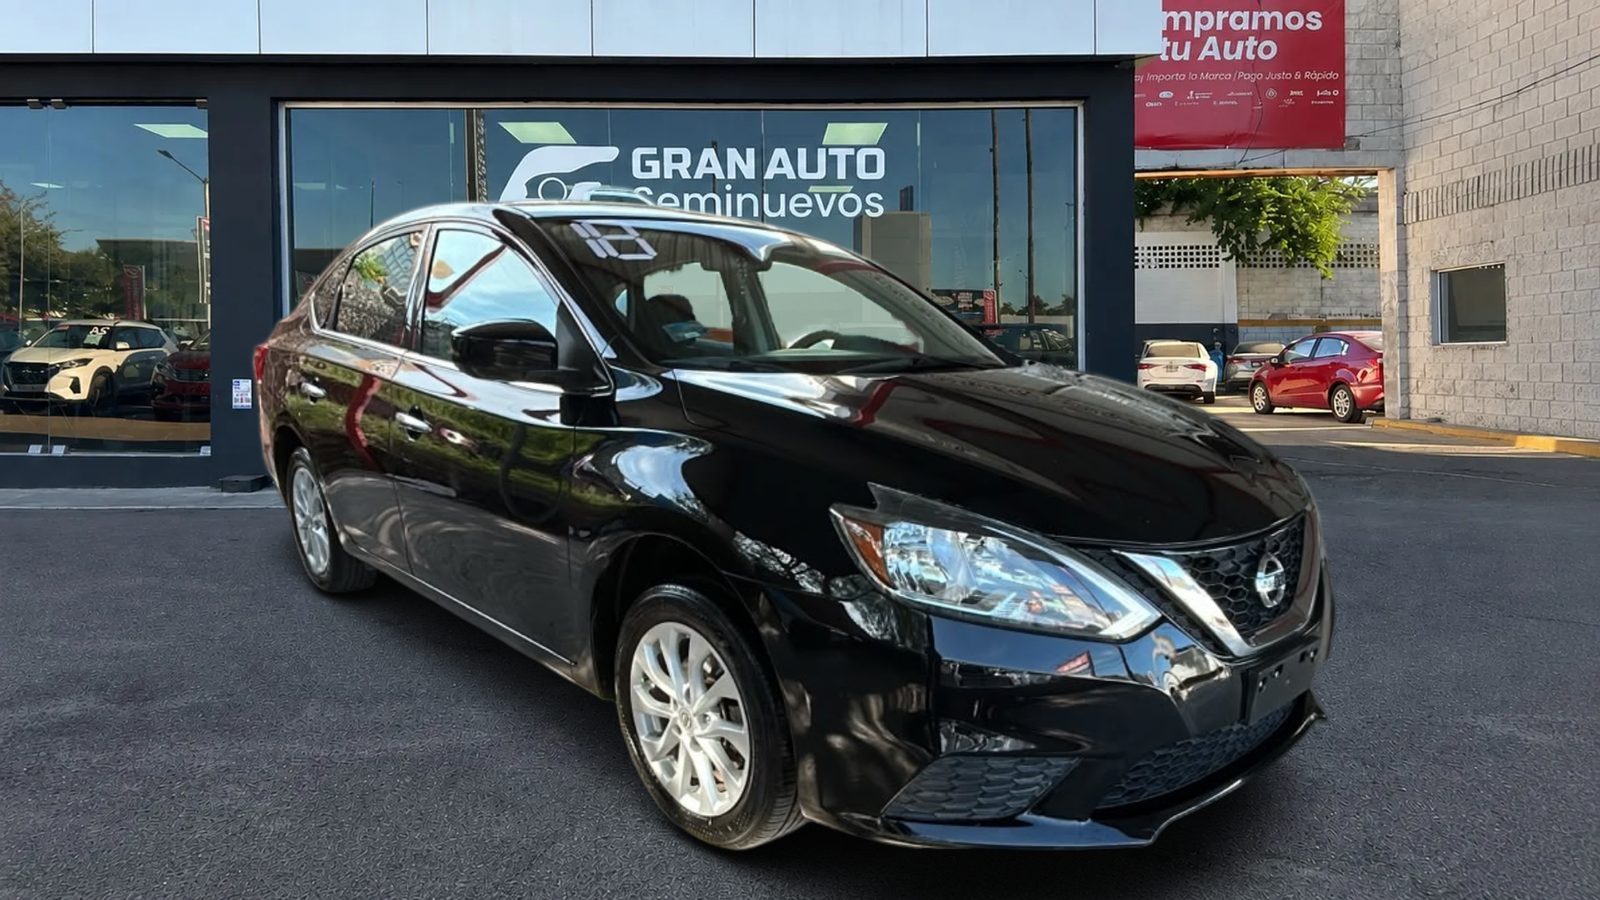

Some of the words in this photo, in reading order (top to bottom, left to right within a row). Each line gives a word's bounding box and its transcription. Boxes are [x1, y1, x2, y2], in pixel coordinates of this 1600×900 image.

[1160, 37, 1191, 61] tu
[1198, 36, 1278, 61] Auto
[1147, 73, 1186, 83] Importa
[1200, 72, 1232, 80] Marca
[1265, 72, 1293, 80] Justo
[1294, 71, 1302, 80] &
[632, 147, 755, 179] GRAN
[763, 147, 886, 179] AUTO
